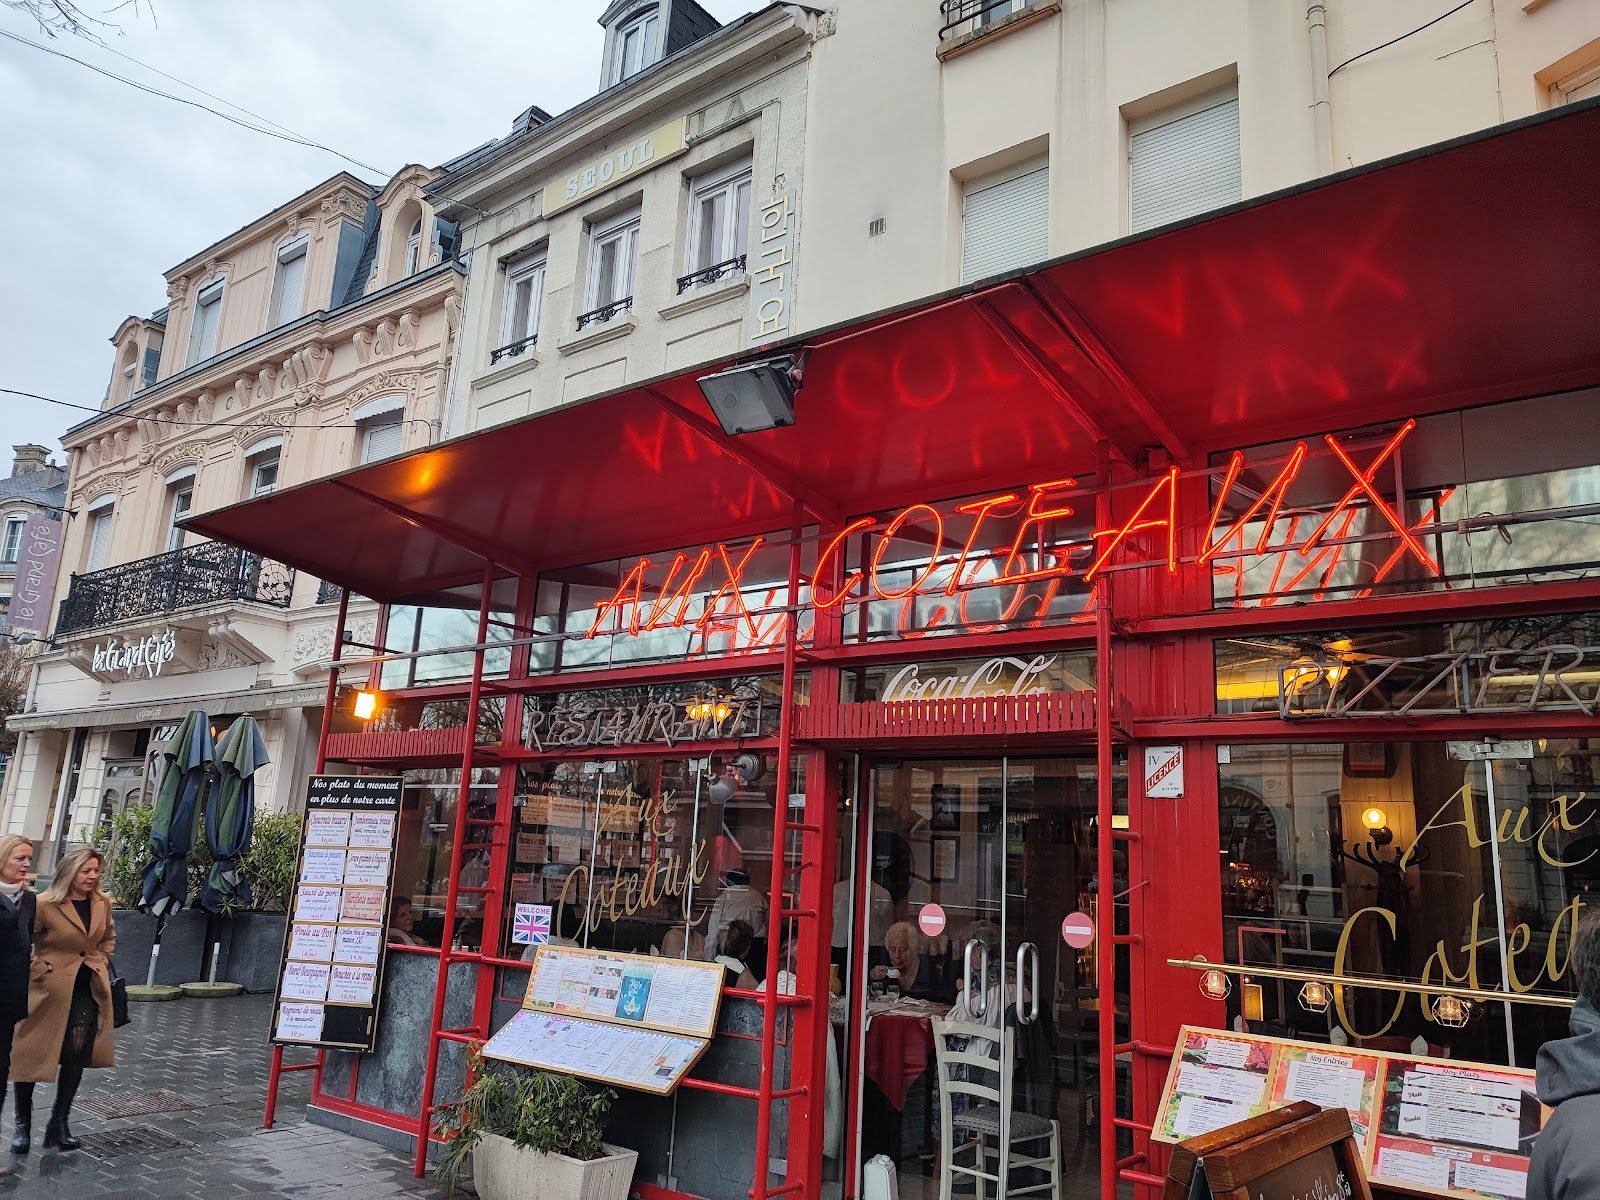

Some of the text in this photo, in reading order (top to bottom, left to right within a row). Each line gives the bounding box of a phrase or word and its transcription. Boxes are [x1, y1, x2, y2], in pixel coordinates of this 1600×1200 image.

[563, 138, 655, 200] SEOUL
[810, 418, 1440, 609] COTEAUX
[15, 525, 57, 621] le Grand Café
[586, 535, 766, 640] AUX
[881, 654, 1058, 702] Coca-Cl
[1281, 644, 1600, 717] PIZZER
[312, 778, 399, 791] Nos plats du moment
[1147, 752, 1180, 791] LICENCE
[1149, 755, 1160, 766] IV
[310, 794, 396, 806] en plus de notre carte
[599, 781, 679, 837] Aux
[1400, 782, 1599, 873] Aux
[300, 887, 338, 899] Sauté de porc
[517, 906, 551, 915] WELCOME
[557, 838, 710, 945] Coteaux
[294, 926, 312, 936] Poule
[321, 927, 333, 938] Pot
[1333, 894, 1587, 1040] Cotea
[1309, 1054, 1322, 1063] Nos
[1442, 1068, 1481, 1078] Nos Plats
